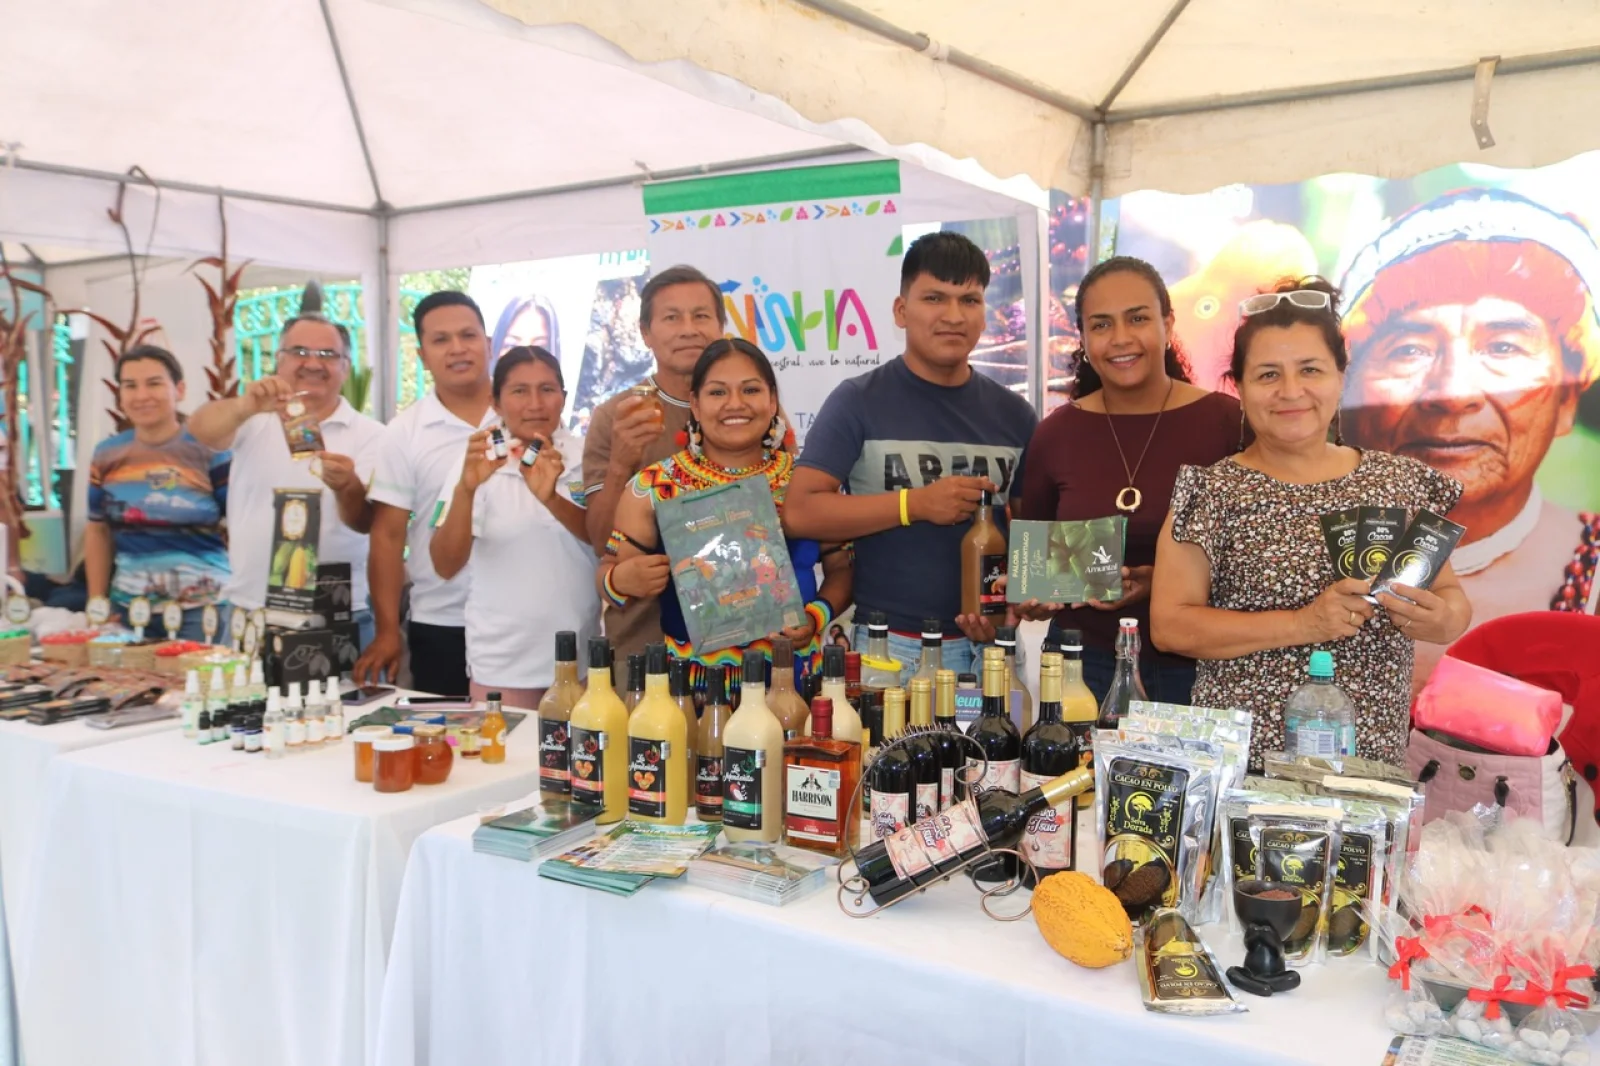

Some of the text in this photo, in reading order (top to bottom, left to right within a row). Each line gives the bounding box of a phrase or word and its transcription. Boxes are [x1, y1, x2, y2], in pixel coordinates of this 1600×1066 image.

[794, 411, 816, 429] TA
[884, 453, 1013, 493] ARMY
[1012, 549, 1020, 578] PALORA
[1114, 774, 1178, 793] CACAO EN POLVO
[792, 790, 832, 807] HARRISON
[1124, 821, 1153, 835] Dorada
[1267, 841, 1290, 850] CACAO
[1343, 845, 1366, 854] POLVO
